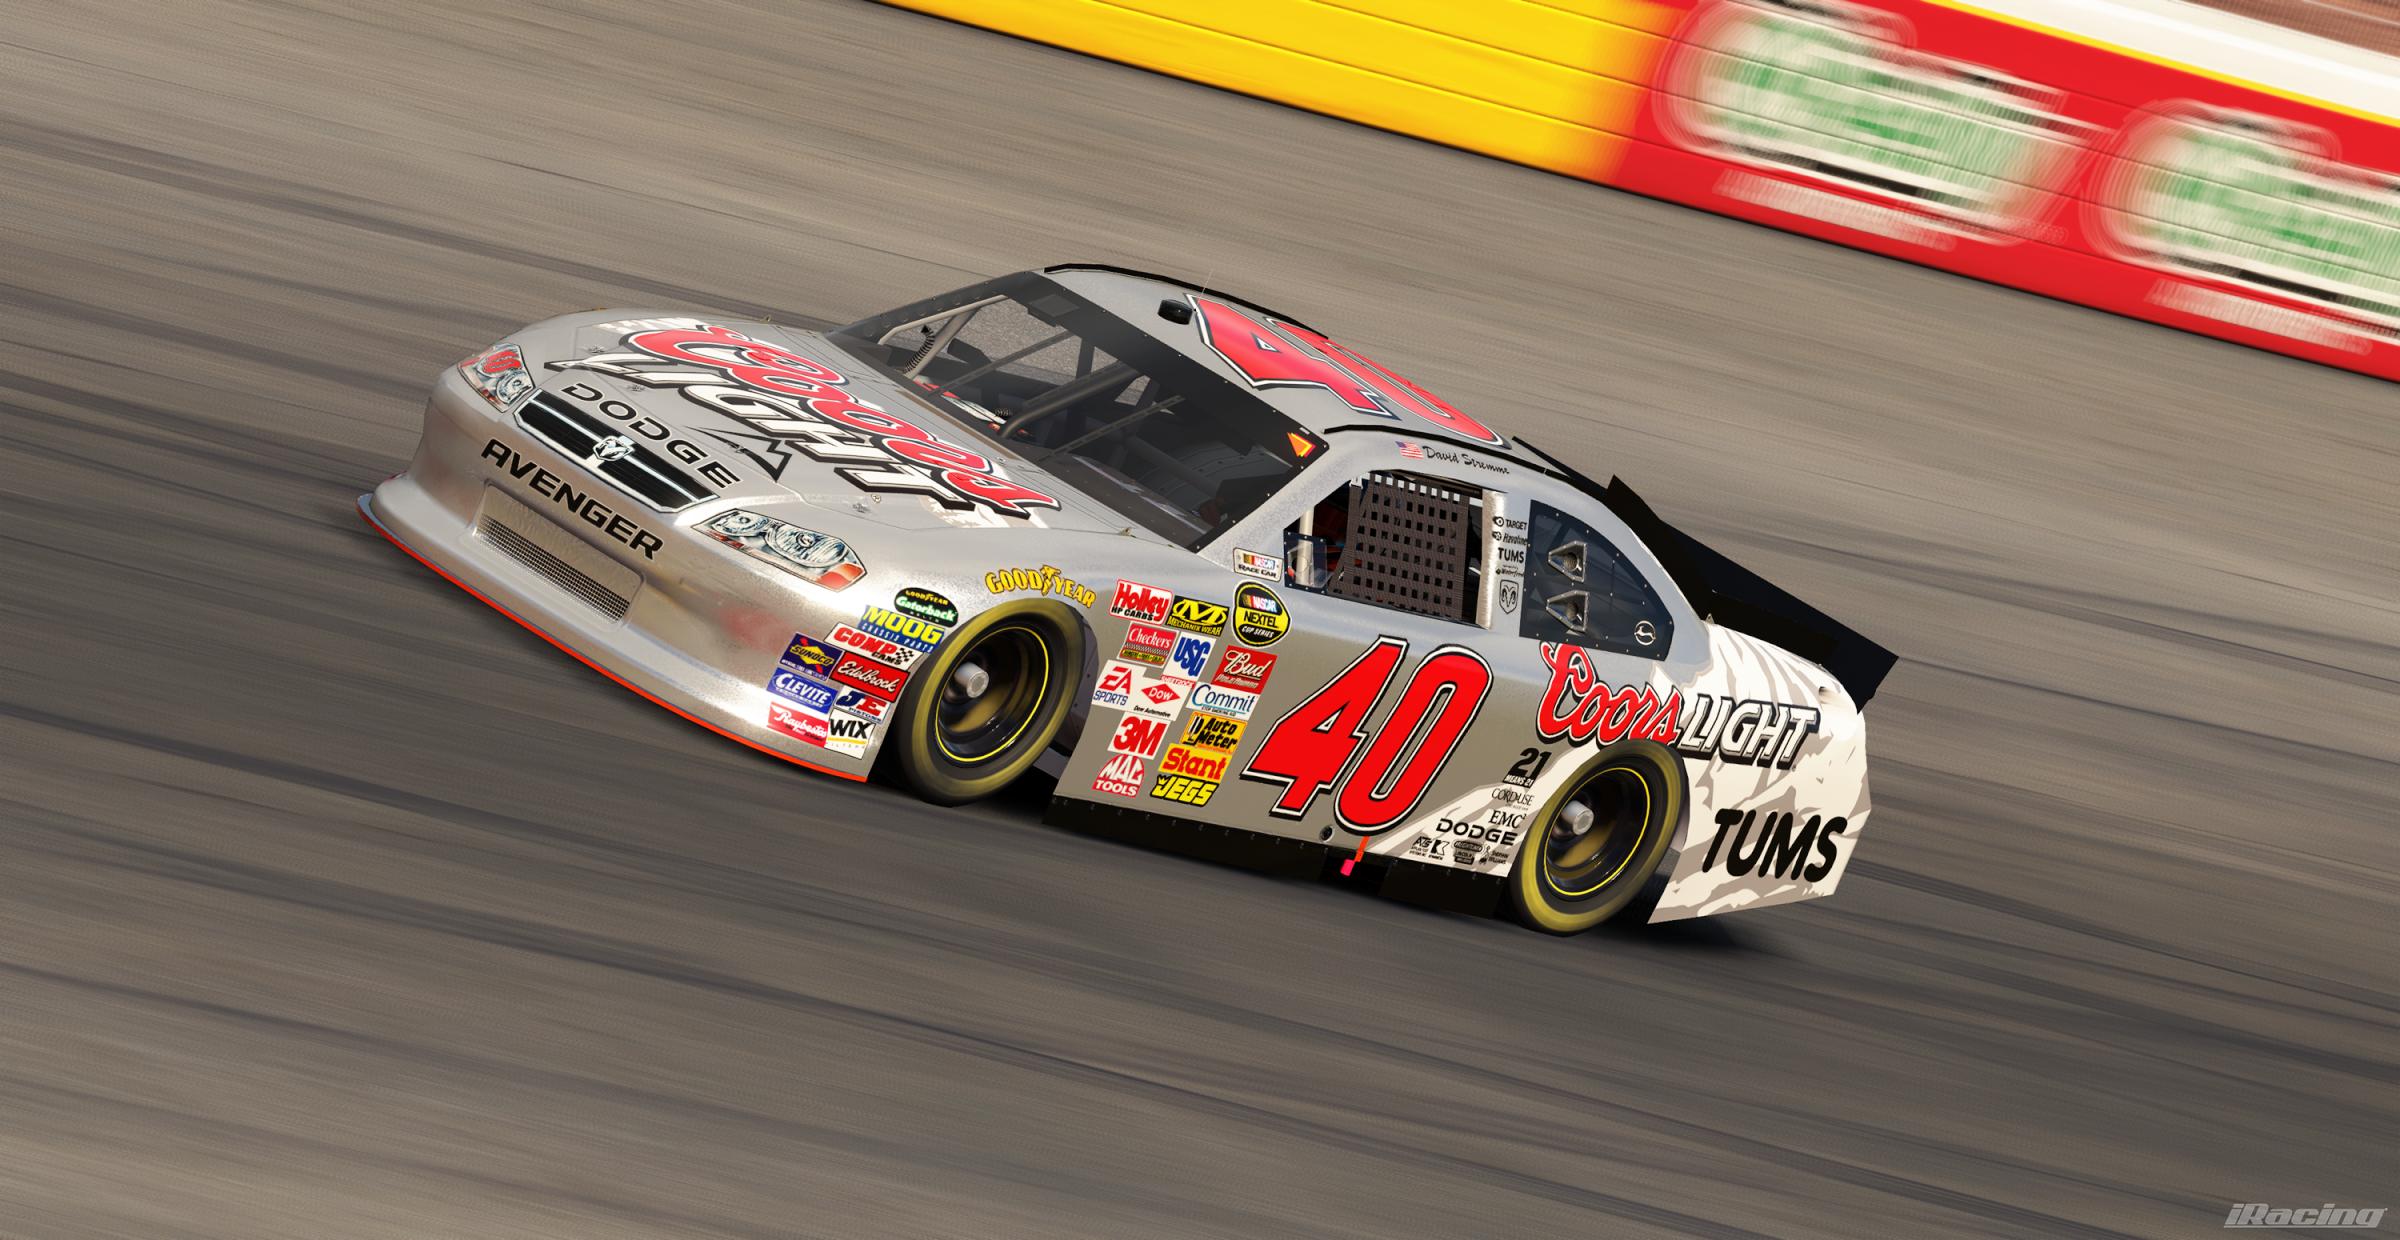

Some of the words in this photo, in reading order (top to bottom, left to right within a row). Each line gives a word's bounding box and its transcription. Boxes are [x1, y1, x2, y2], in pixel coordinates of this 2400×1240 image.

[1184, 292, 1512, 450] 40
[544, 353, 978, 511] LIGHT
[561, 382, 741, 490] DODGE
[618, 325, 1061, 519] Coors
[1421, 445, 1460, 464] David
[481, 438, 665, 561] AVENGER
[1504, 518, 1528, 531] TARGET
[1252, 556, 1277, 570] NASCAR
[1497, 547, 1525, 564] TUMS
[1238, 563, 1259, 575] RACE
[1260, 567, 1278, 579] CAR
[984, 564, 1097, 609] GOODYEAR
[1116, 581, 1170, 621] Holley
[895, 595, 957, 622] Gatorback
[1111, 606, 1123, 617] HP
[1123, 608, 1155, 621] CARBS
[1250, 594, 1278, 613] NASCAR
[863, 606, 944, 645] MOOG
[1167, 615, 1201, 632] MECHANIX
[1200, 625, 1222, 637] WEAR
[1241, 625, 1253, 635] CUP
[1252, 627, 1275, 639] SERIES
[1243, 611, 1279, 629] NEXTEL
[832, 625, 898, 657] COMP
[1128, 626, 1173, 650] Checkers
[790, 645, 834, 666] SUNOCO
[871, 650, 903, 666] CAMS
[1173, 636, 1211, 677] USG
[1225, 650, 1273, 679] Bud
[775, 672, 832, 705] CLEVITE
[837, 660, 901, 693] Edelbrock
[1097, 665, 1132, 695] EA
[1093, 690, 1129, 707] SPORTS
[1133, 704, 1146, 713] Dow
[1145, 707, 1171, 718] Automotive
[1192, 683, 1256, 714] Commit
[1536, 639, 1685, 749] Coors
[1678, 693, 1821, 770] LIGHT
[772, 707, 828, 738] Raybestos
[829, 718, 874, 740] WIX
[1113, 715, 1169, 757] 3M
[1203, 717, 1238, 736] Auto
[1239, 634, 1494, 836] 40
[1197, 730, 1239, 750] Meter
[1098, 754, 1144, 785] MAC
[1162, 746, 1227, 781] Stant
[1504, 747, 1552, 778] 21
[1095, 779, 1138, 797] TOOLS
[1150, 773, 1220, 807] JEGS
[1436, 818, 1518, 846] DODGE
[1701, 808, 1848, 883] TUMS
